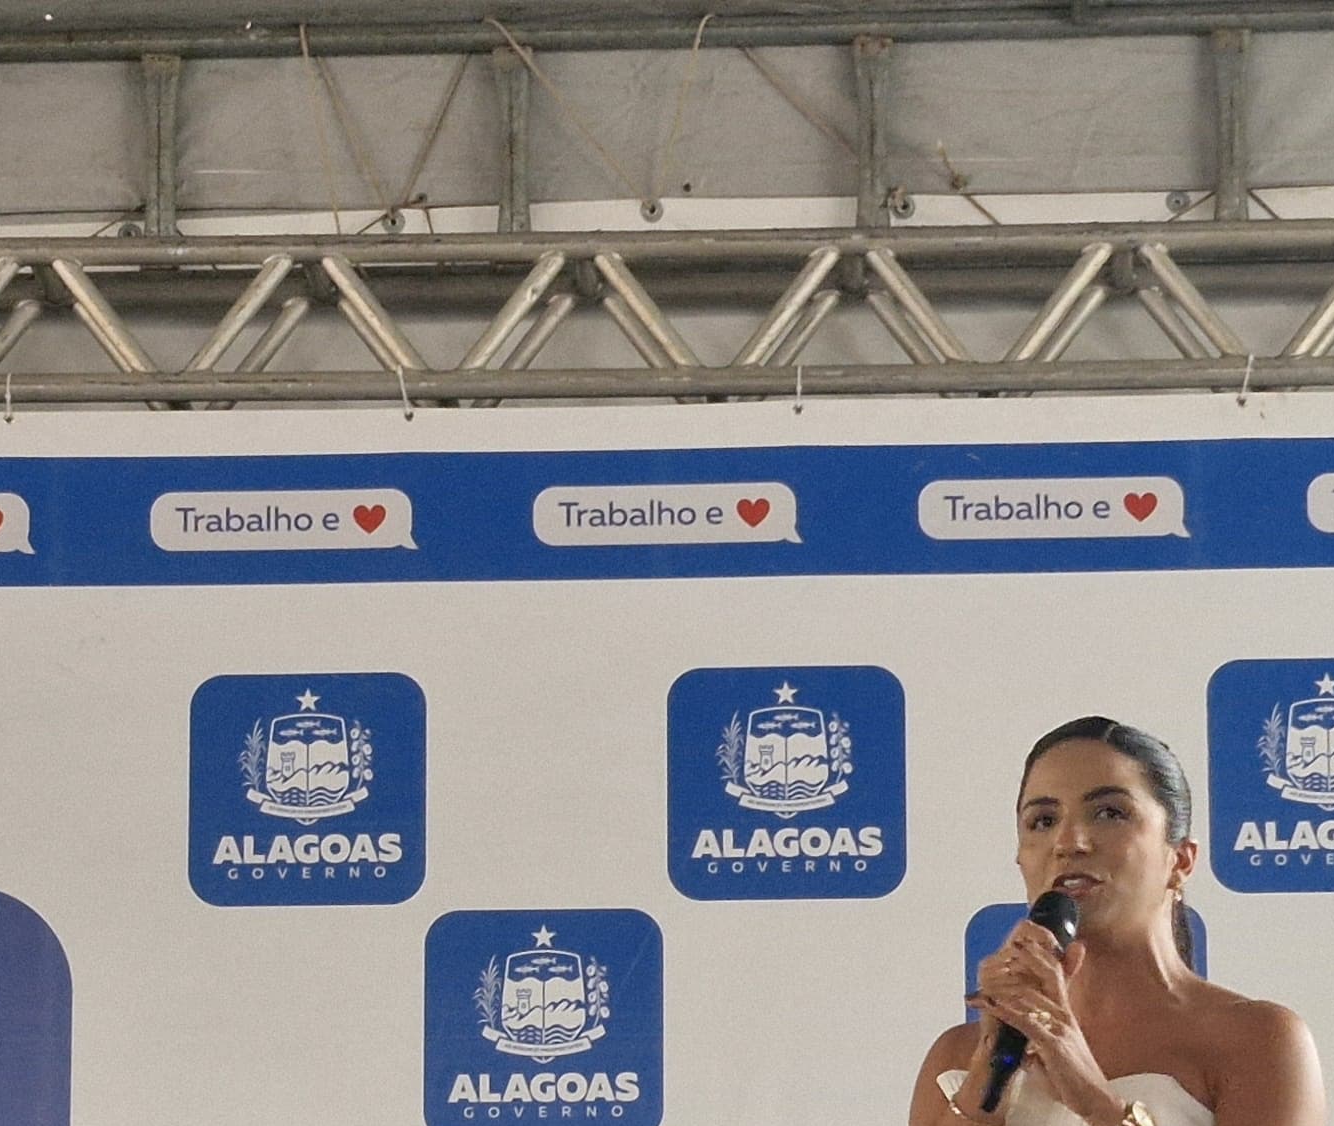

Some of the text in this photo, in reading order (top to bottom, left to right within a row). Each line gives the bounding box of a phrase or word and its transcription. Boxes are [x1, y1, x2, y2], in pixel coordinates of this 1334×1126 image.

[175, 505, 339, 532] Trabalho e
[558, 500, 723, 527] Trabalho e
[943, 494, 1110, 521] Trabalho e
[213, 833, 402, 864] ALAGOAS
[692, 827, 883, 858] ALAGOAS
[228, 866, 386, 880] GOVERNO
[708, 860, 867, 874] GOVERNO
[448, 1072, 639, 1103] ALAGOAS
[464, 1105, 623, 1119] GOVERNO
